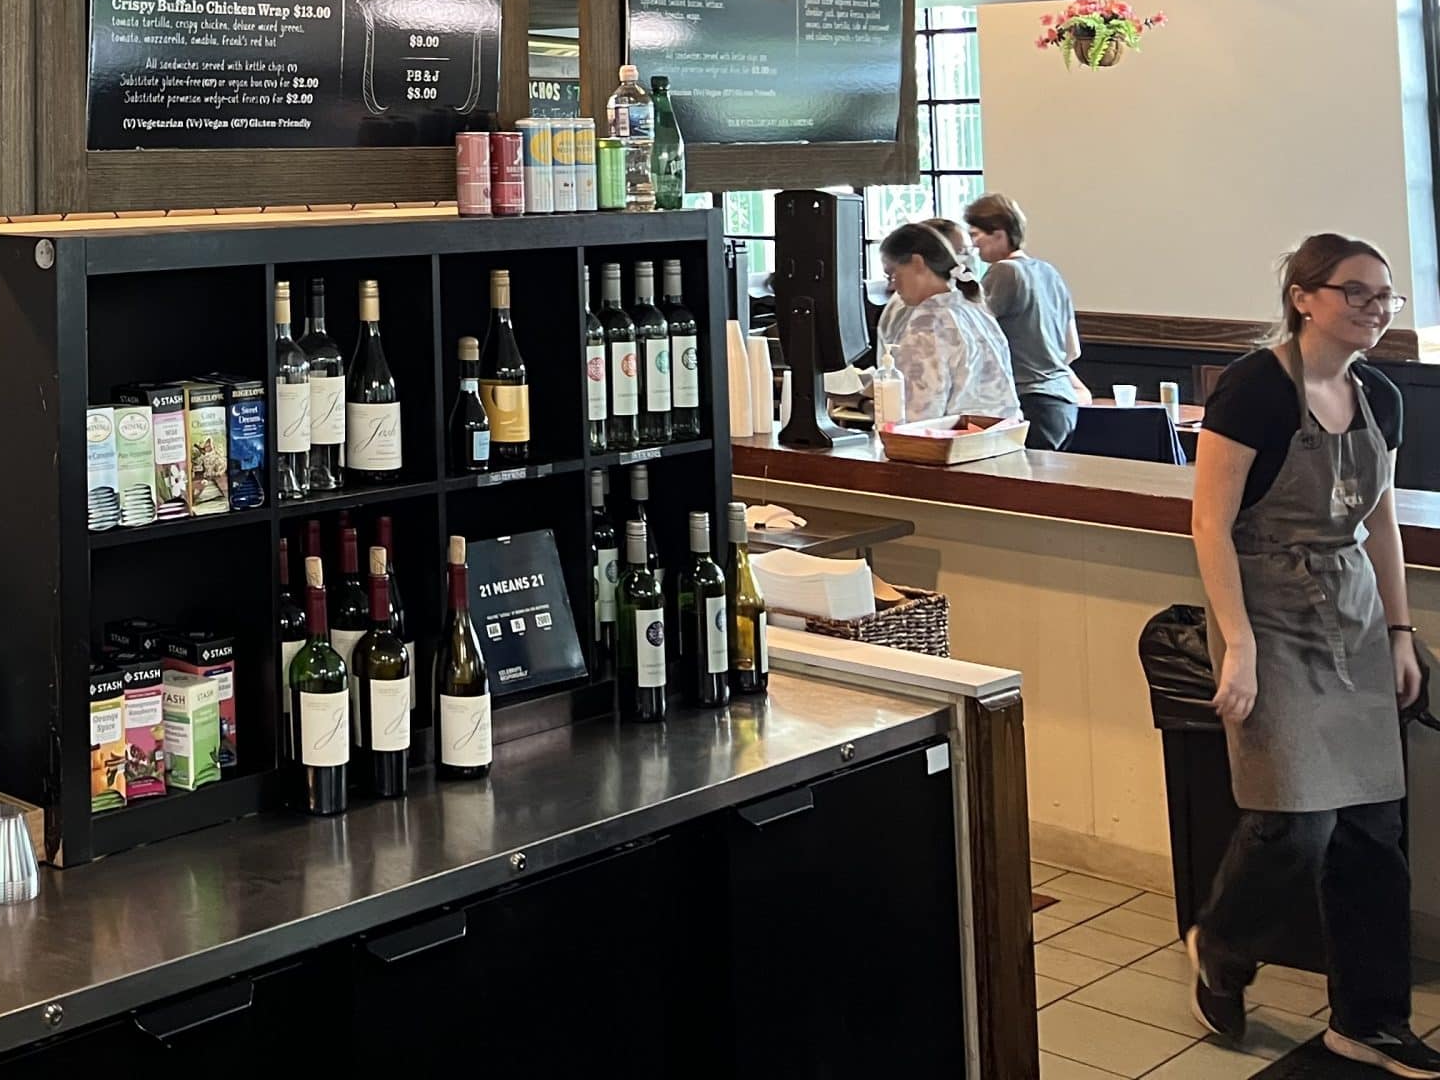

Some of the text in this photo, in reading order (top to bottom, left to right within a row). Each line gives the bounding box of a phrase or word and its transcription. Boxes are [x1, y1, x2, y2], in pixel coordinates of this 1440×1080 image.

[157, 0, 204, 14] Buffalo
[206, 1, 256, 15] Chicken
[257, 3, 290, 20] Wrap
[293, 4, 331, 19] $13.00
[409, 34, 439, 48] $9.00
[406, 70, 440, 82] PB & J
[407, 86, 437, 100] $8.00
[160, 394, 184, 406] STASH
[479, 573, 545, 598] 21 MEANS 21
[168, 644, 188, 656] STASH
[210, 646, 233, 659] STASH
[133, 669, 160, 682] STASH
[97, 680, 123, 694] STASH
